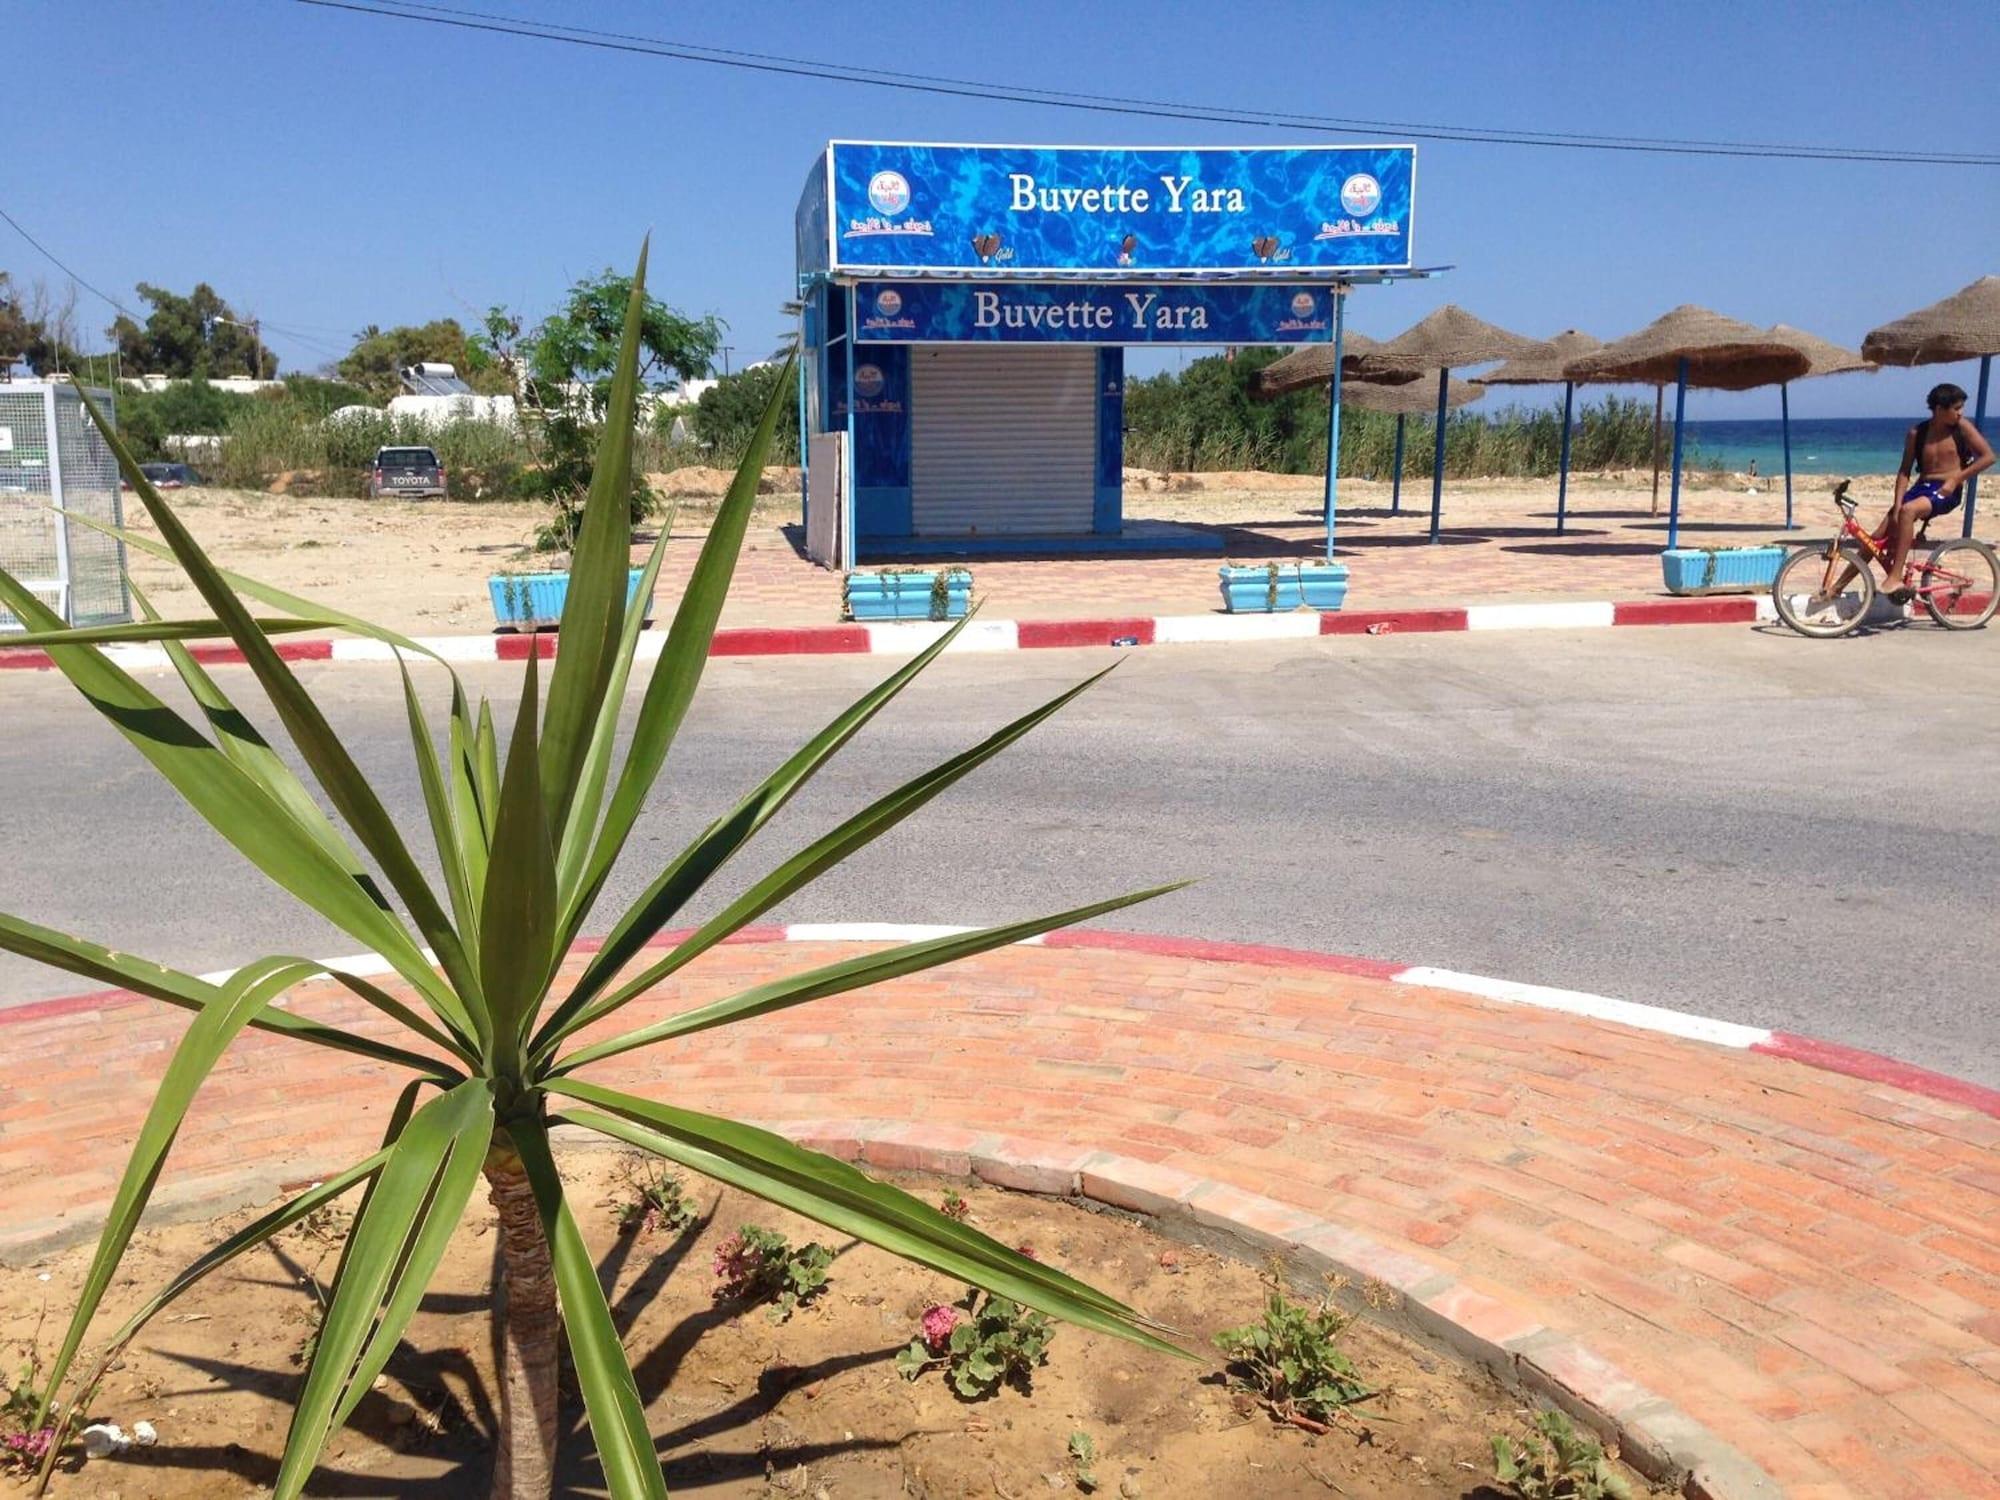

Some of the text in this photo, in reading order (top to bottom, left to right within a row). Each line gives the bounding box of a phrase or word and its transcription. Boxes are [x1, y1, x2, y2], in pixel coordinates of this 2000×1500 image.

[1009, 174, 1245, 213] Buvette Yara
[974, 292, 1209, 329] Buvette Yara
[392, 476, 431, 486] TOYOTA
